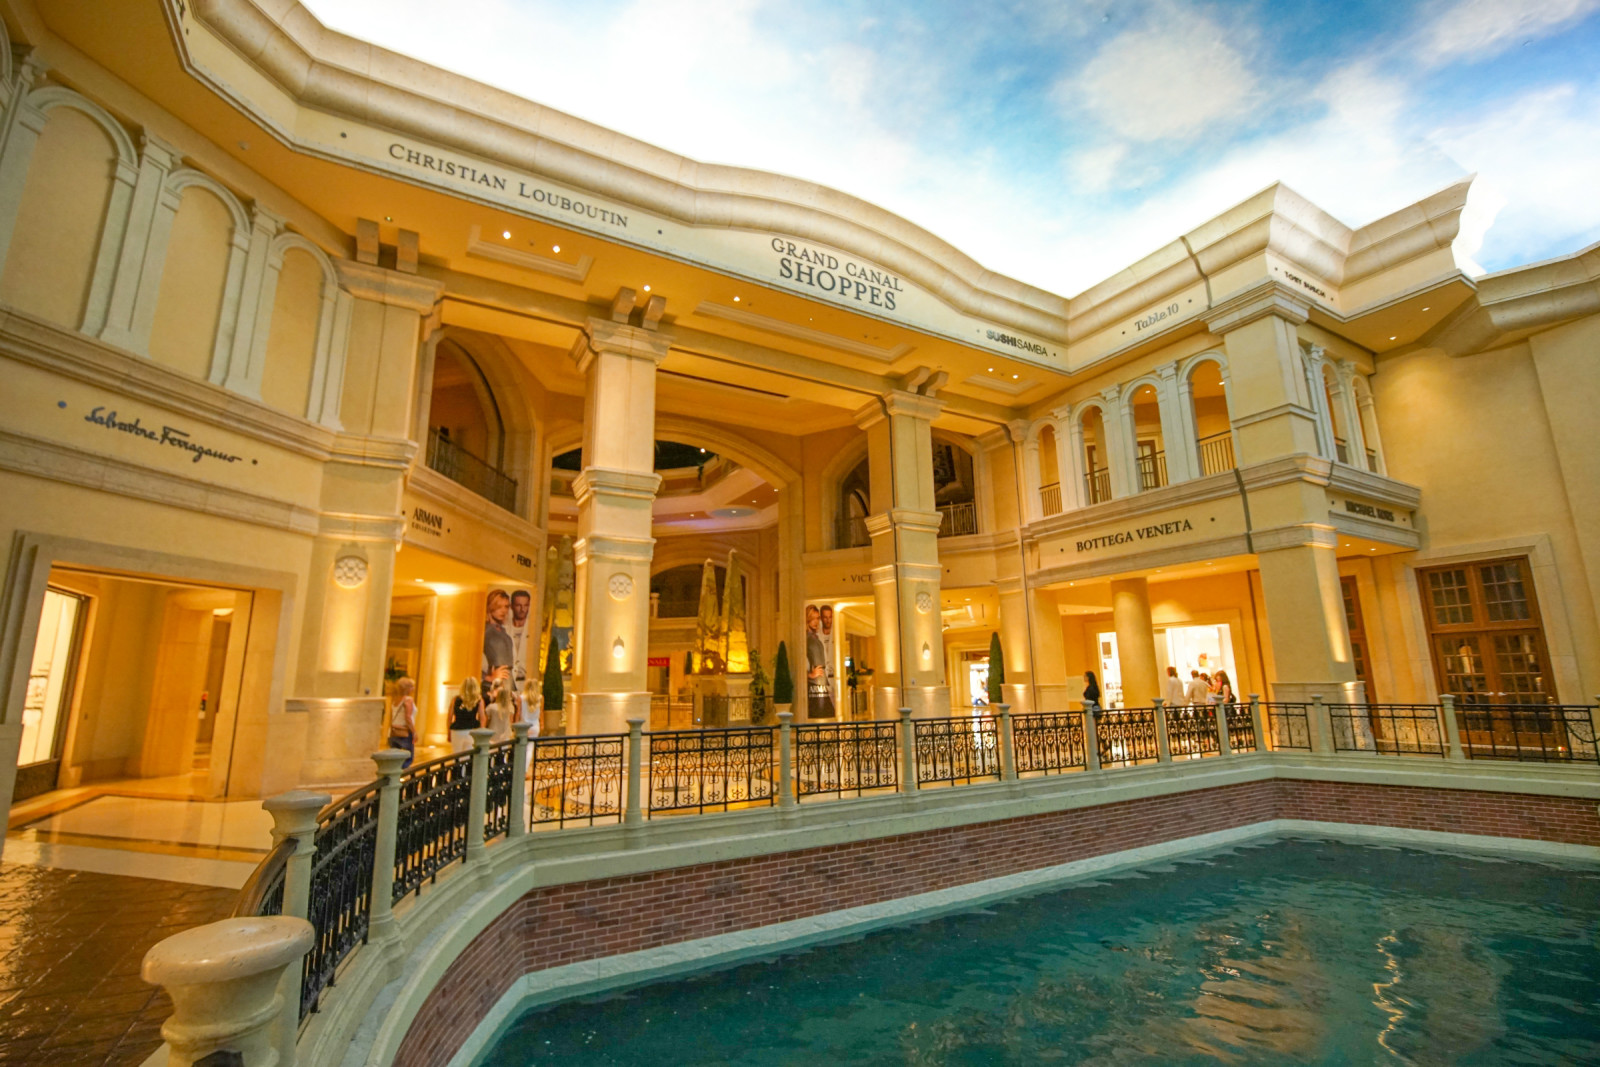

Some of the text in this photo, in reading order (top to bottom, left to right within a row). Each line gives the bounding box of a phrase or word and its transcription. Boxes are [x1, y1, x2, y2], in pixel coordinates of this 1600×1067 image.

[389, 143, 629, 228] CHRISTIAN LOUBOUTIN
[771, 238, 903, 292] GRAND CANAL
[779, 257, 897, 311] SHOPPES
[84, 407, 243, 463] Salvatore Ferragamo
[412, 507, 443, 530] ARMANI
[1076, 519, 1193, 552] BOTTEGA VENETA
[850, 573, 873, 583] VICT
